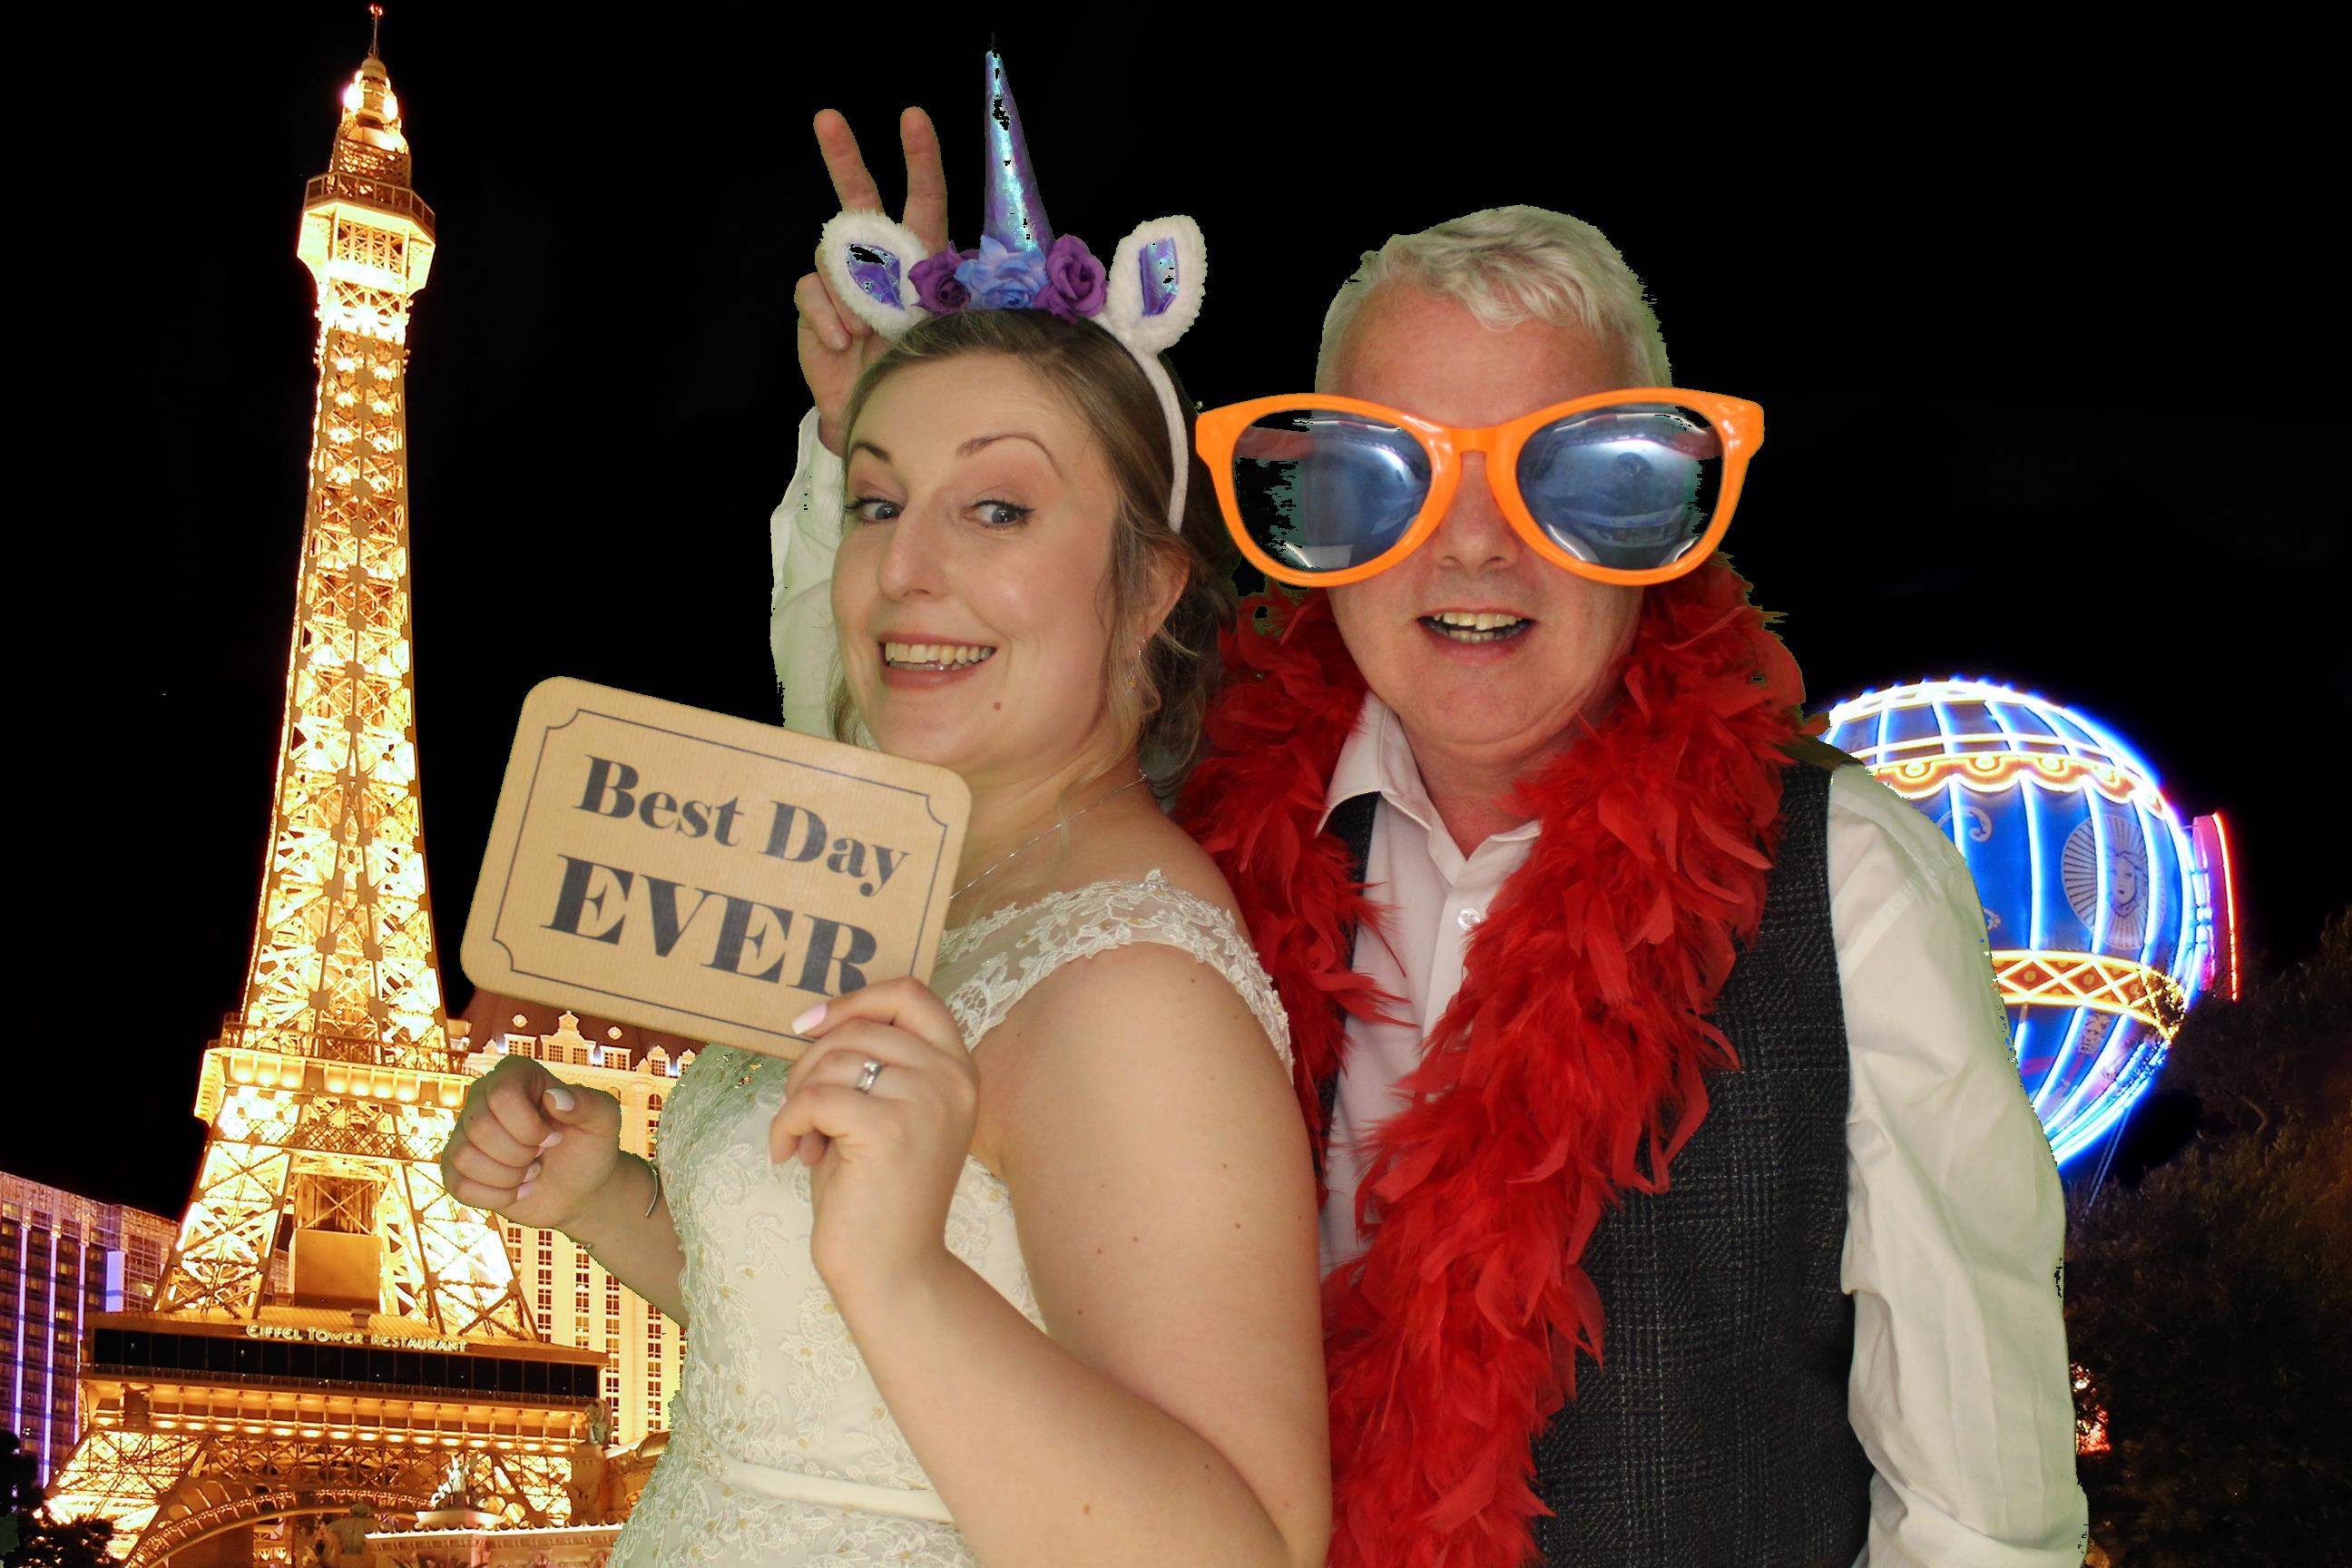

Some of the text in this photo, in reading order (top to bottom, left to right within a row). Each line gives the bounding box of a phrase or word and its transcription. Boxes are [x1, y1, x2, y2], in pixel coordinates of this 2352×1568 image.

[573, 754, 911, 897] Best Day
[540, 853, 879, 998] EVER
[245, 1324, 468, 1352] EIFFEL TOWER RESTAURANT
